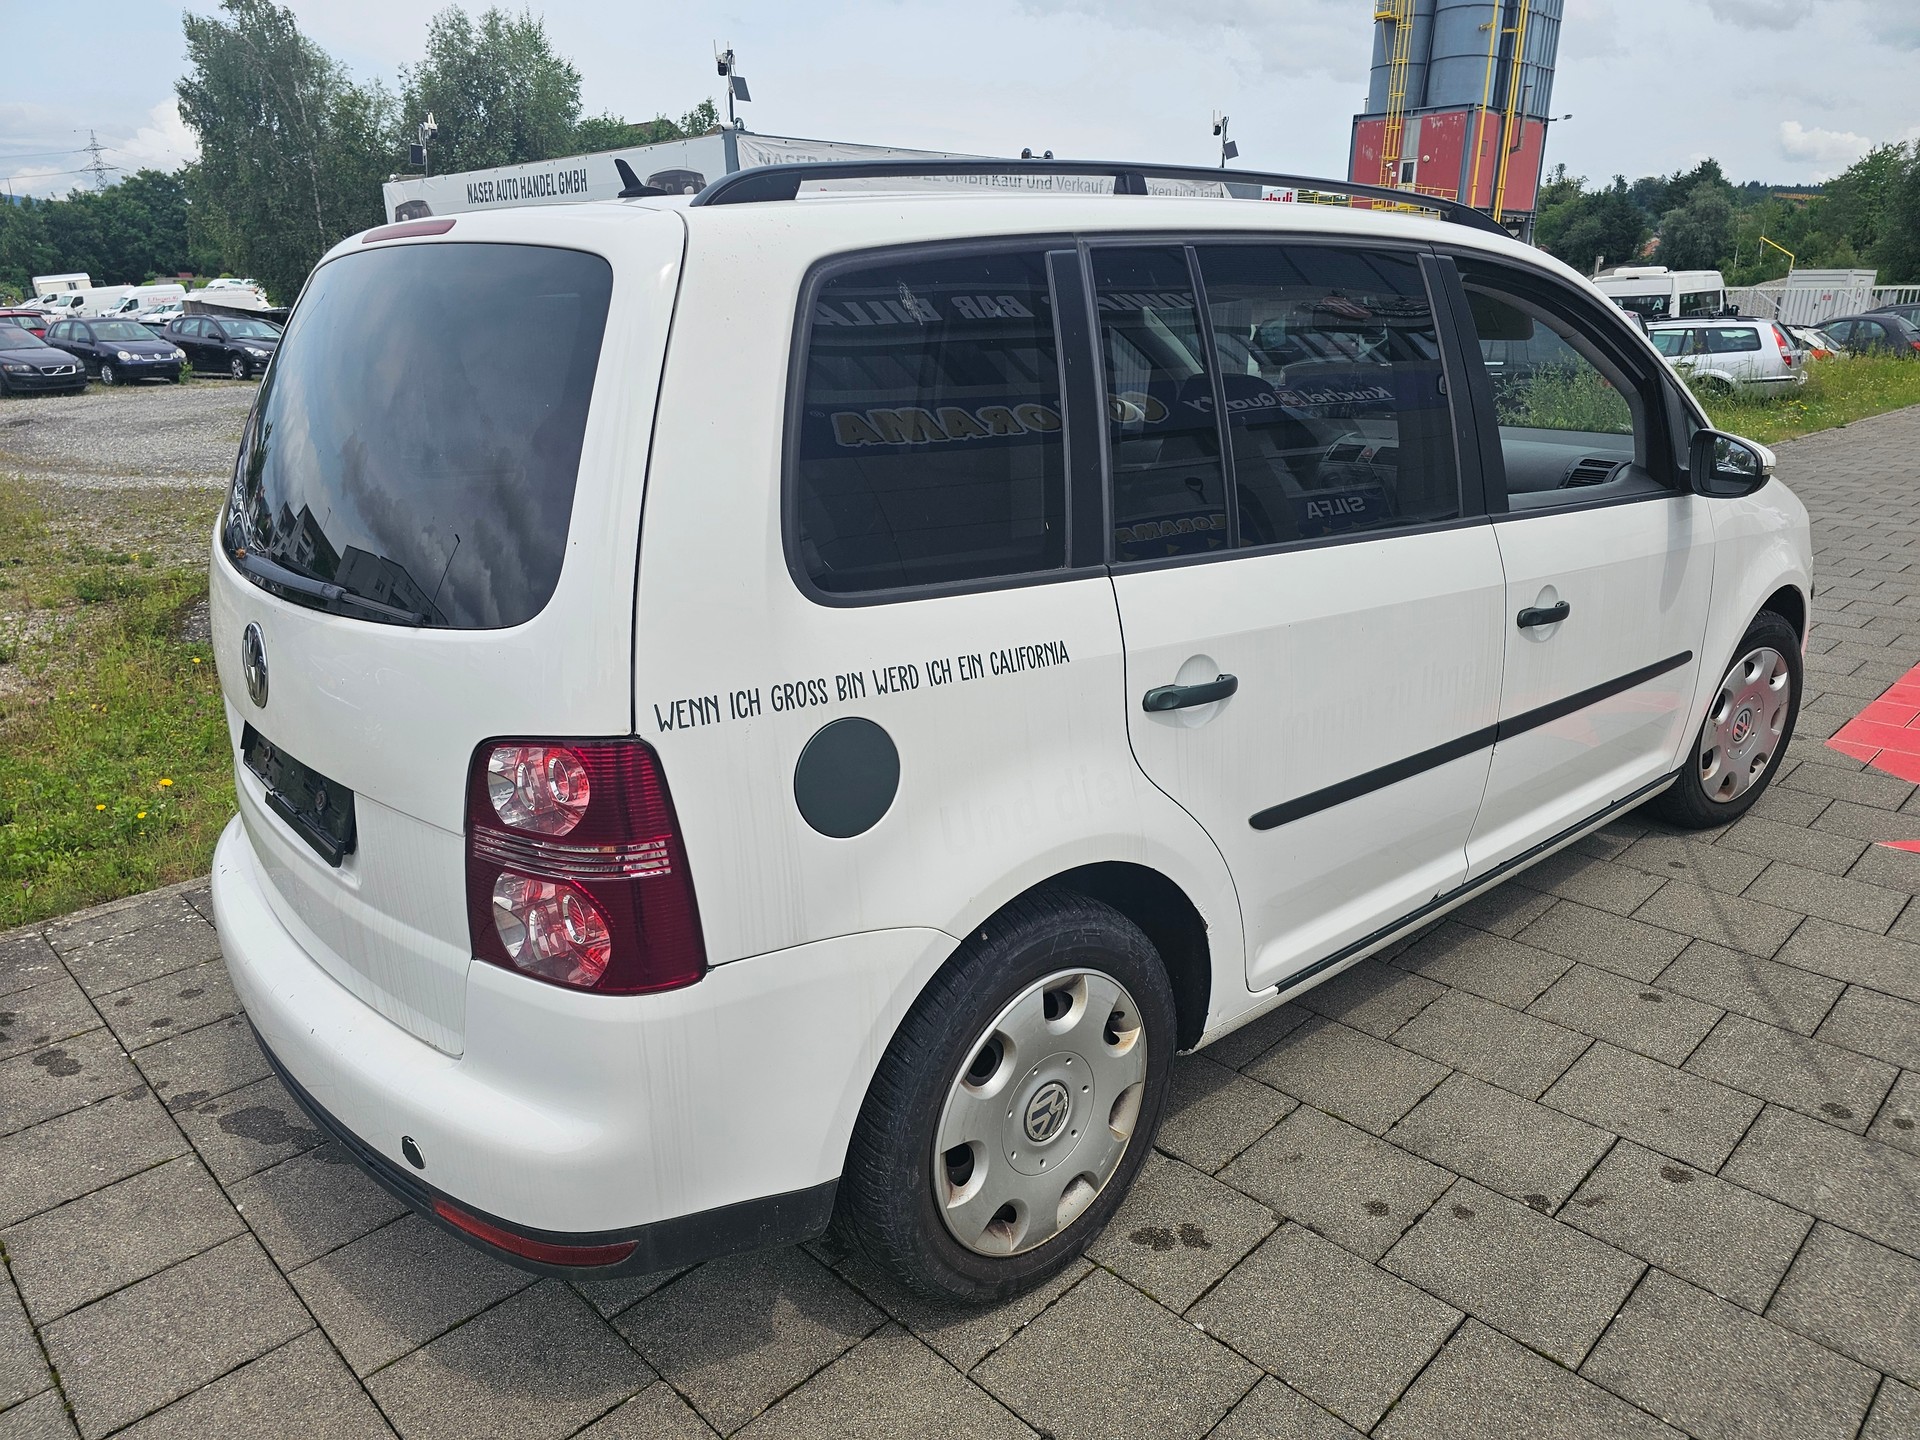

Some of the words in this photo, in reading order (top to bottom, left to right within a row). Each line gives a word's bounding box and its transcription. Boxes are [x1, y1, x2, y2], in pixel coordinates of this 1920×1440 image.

[467, 181, 495, 204] NASER
[496, 178, 519, 201] AUTO
[520, 173, 557, 199] HANDEL
[559, 168, 588, 195] GMBH
[1027, 175, 1052, 190] Und
[1056, 176, 1104, 194] Verkauf
[653, 694, 721, 733] WENN
[729, 688, 762, 719] ICH
[771, 678, 829, 711] GROSS
[835, 671, 866, 701] BIN
[873, 664, 920, 694] WERD
[925, 657, 953, 687] ICH
[958, 653, 985, 681] EIN
[989, 639, 1071, 675] CALIFORNIA
